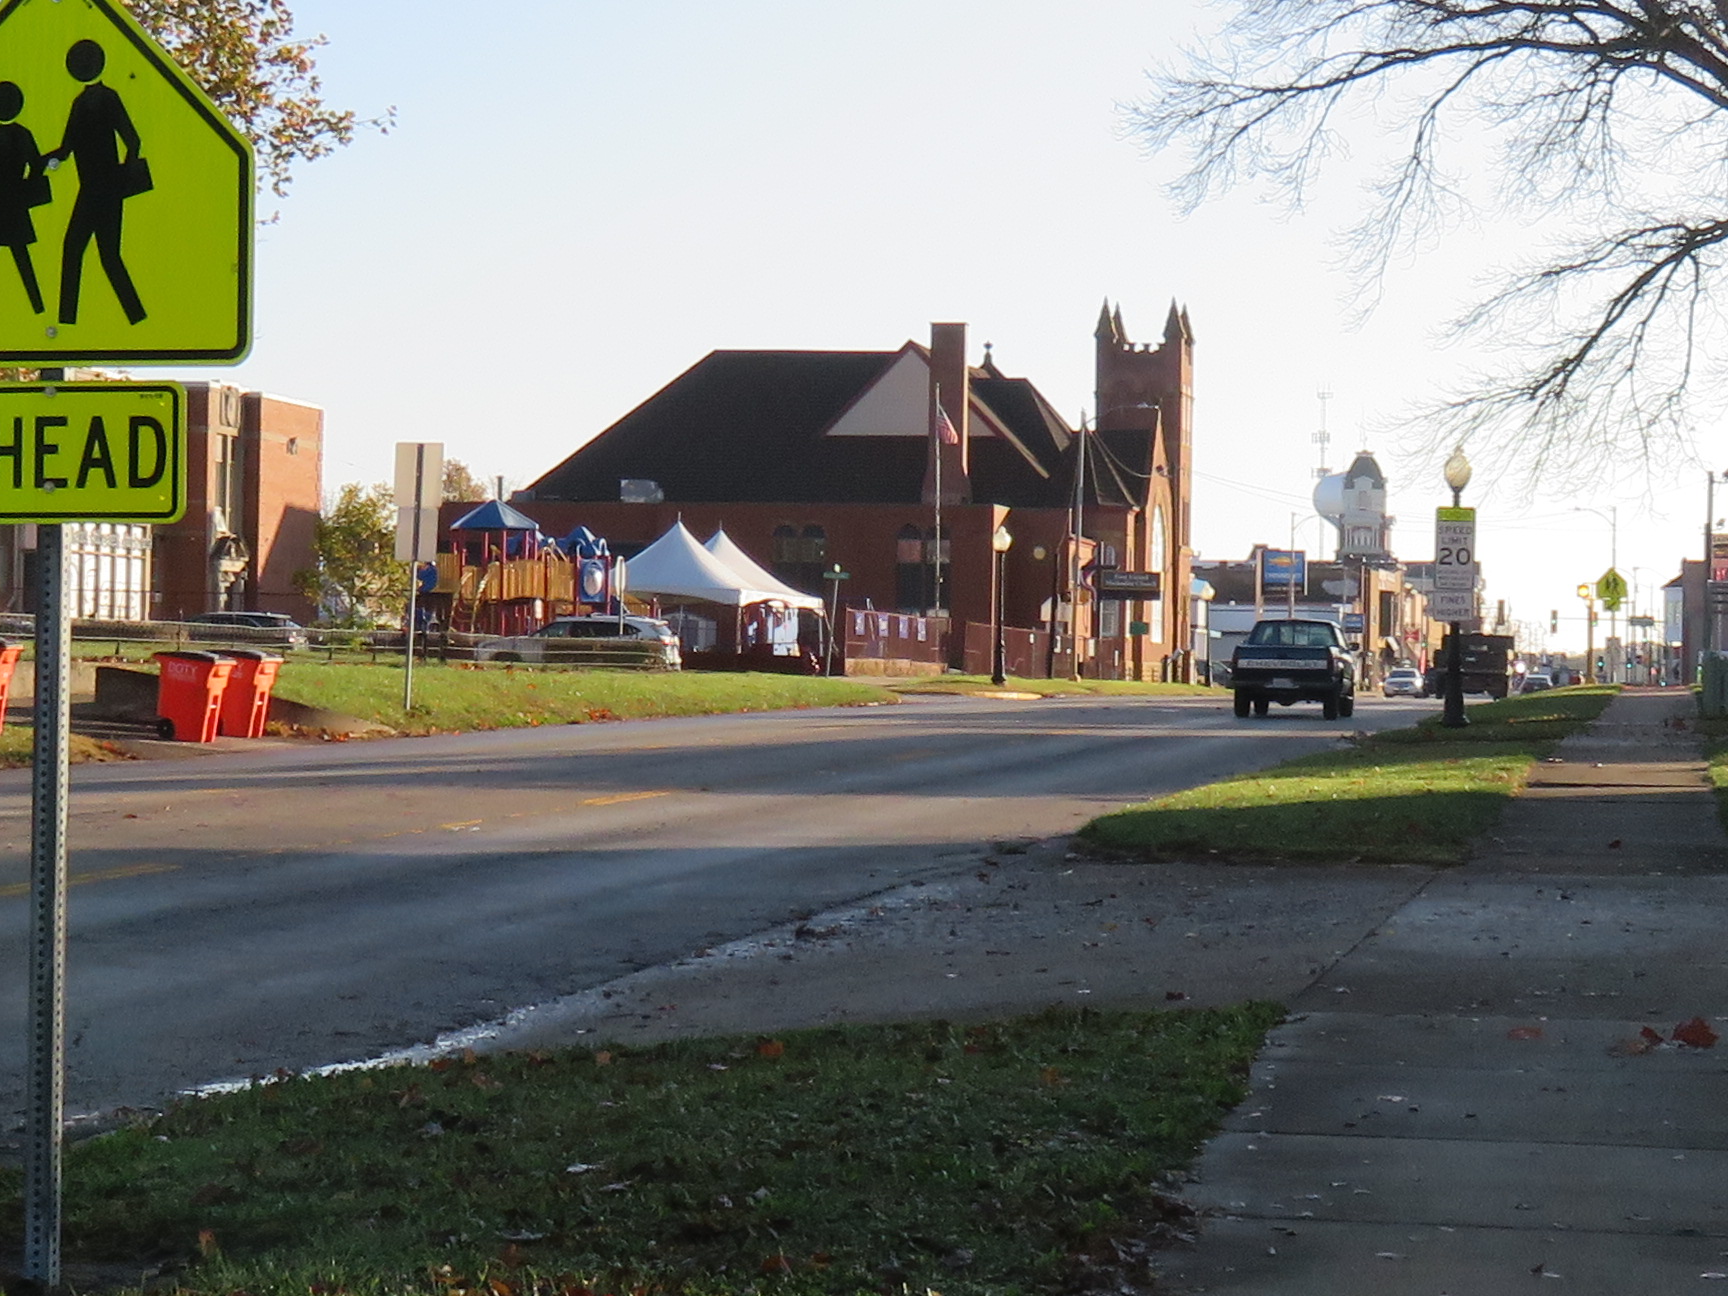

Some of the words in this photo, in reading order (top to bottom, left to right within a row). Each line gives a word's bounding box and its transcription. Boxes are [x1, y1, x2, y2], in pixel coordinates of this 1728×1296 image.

[1438, 526, 1472, 535] SPEED
[1441, 537, 1468, 545] LIMIT
[1438, 548, 1471, 565] 20
[1440, 595, 1466, 604] FINES
[1437, 608, 1470, 618] HIGHER
[168, 661, 198, 675] DOTY
